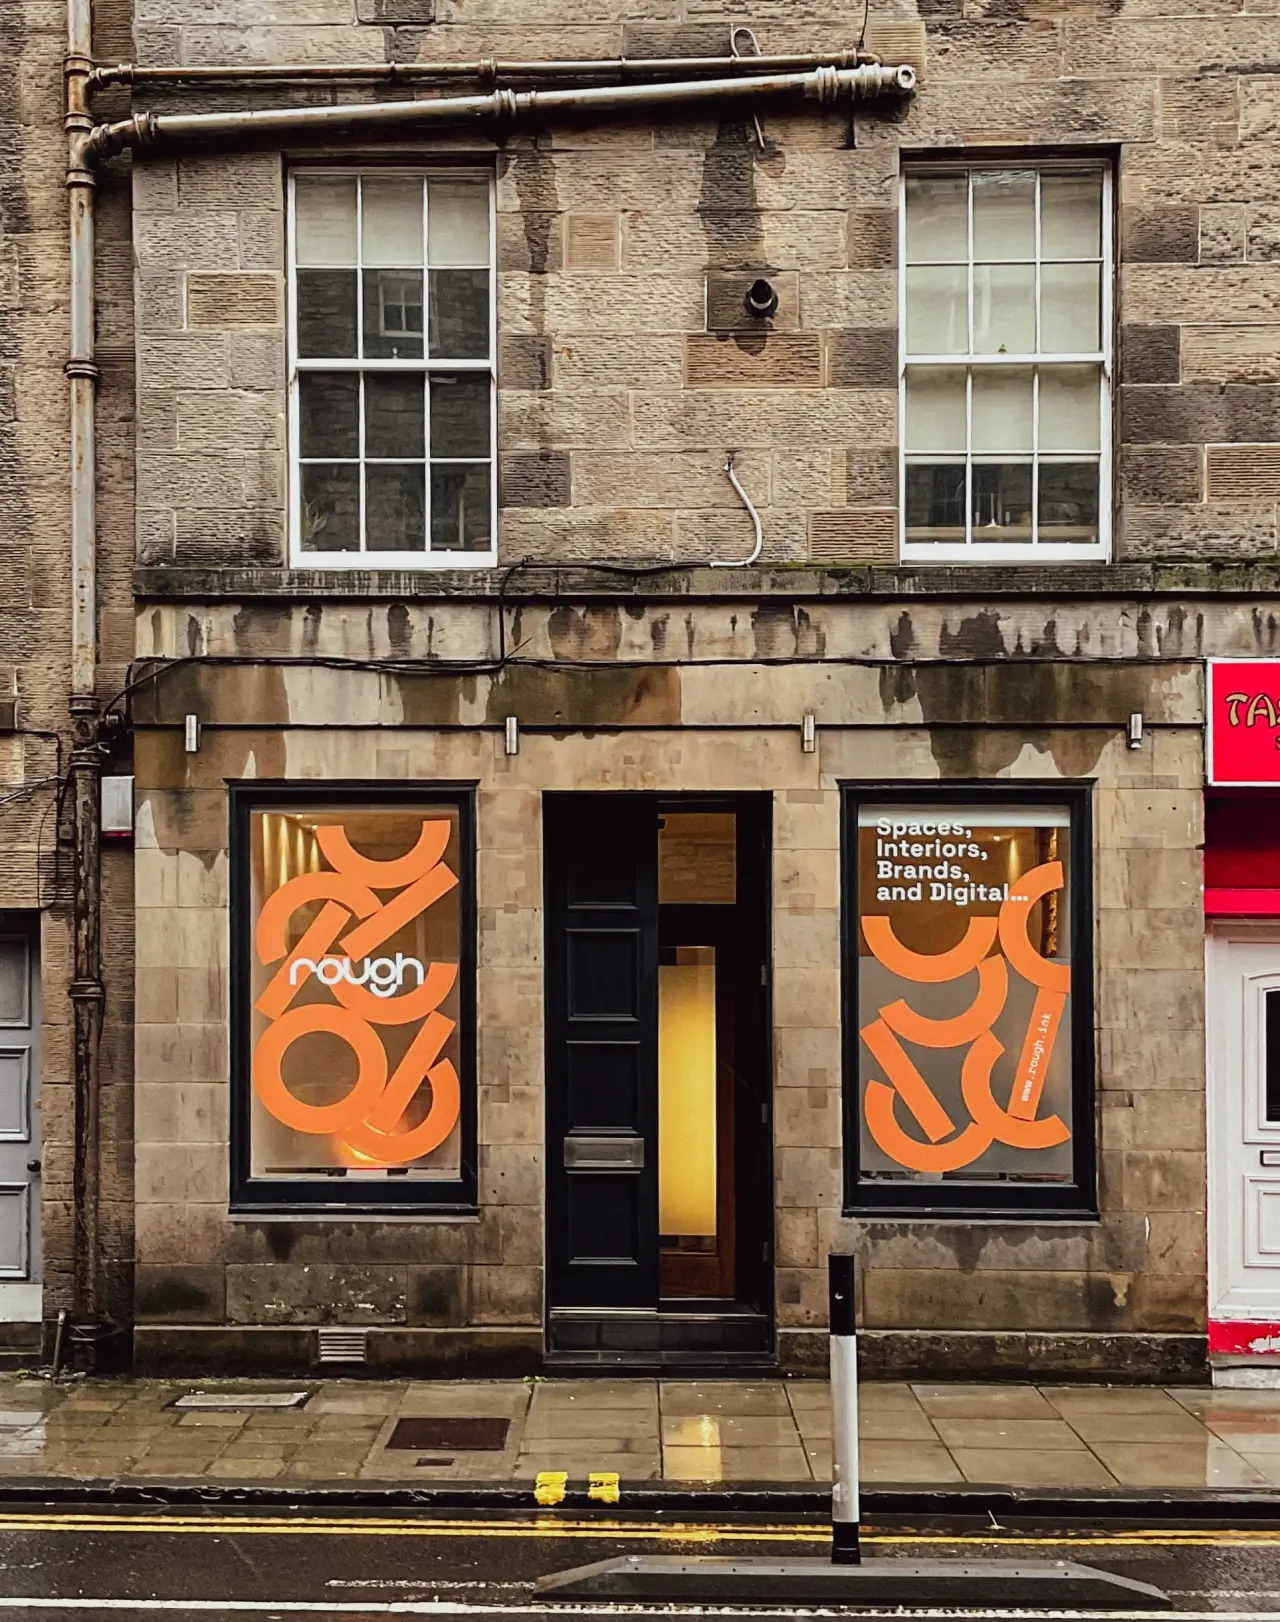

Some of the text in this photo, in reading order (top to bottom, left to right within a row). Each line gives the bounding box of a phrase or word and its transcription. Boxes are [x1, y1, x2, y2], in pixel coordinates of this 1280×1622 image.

[1225, 692, 1280, 728] TA
[876, 817, 972, 839] Spaces,
[877, 838, 988, 861] Interiors,
[876, 860, 970, 882] Brands,
[876, 882, 1029, 906] and Digital...
[289, 952, 424, 998] rough
[1021, 1012, 1052, 1102] www.rough.ink
